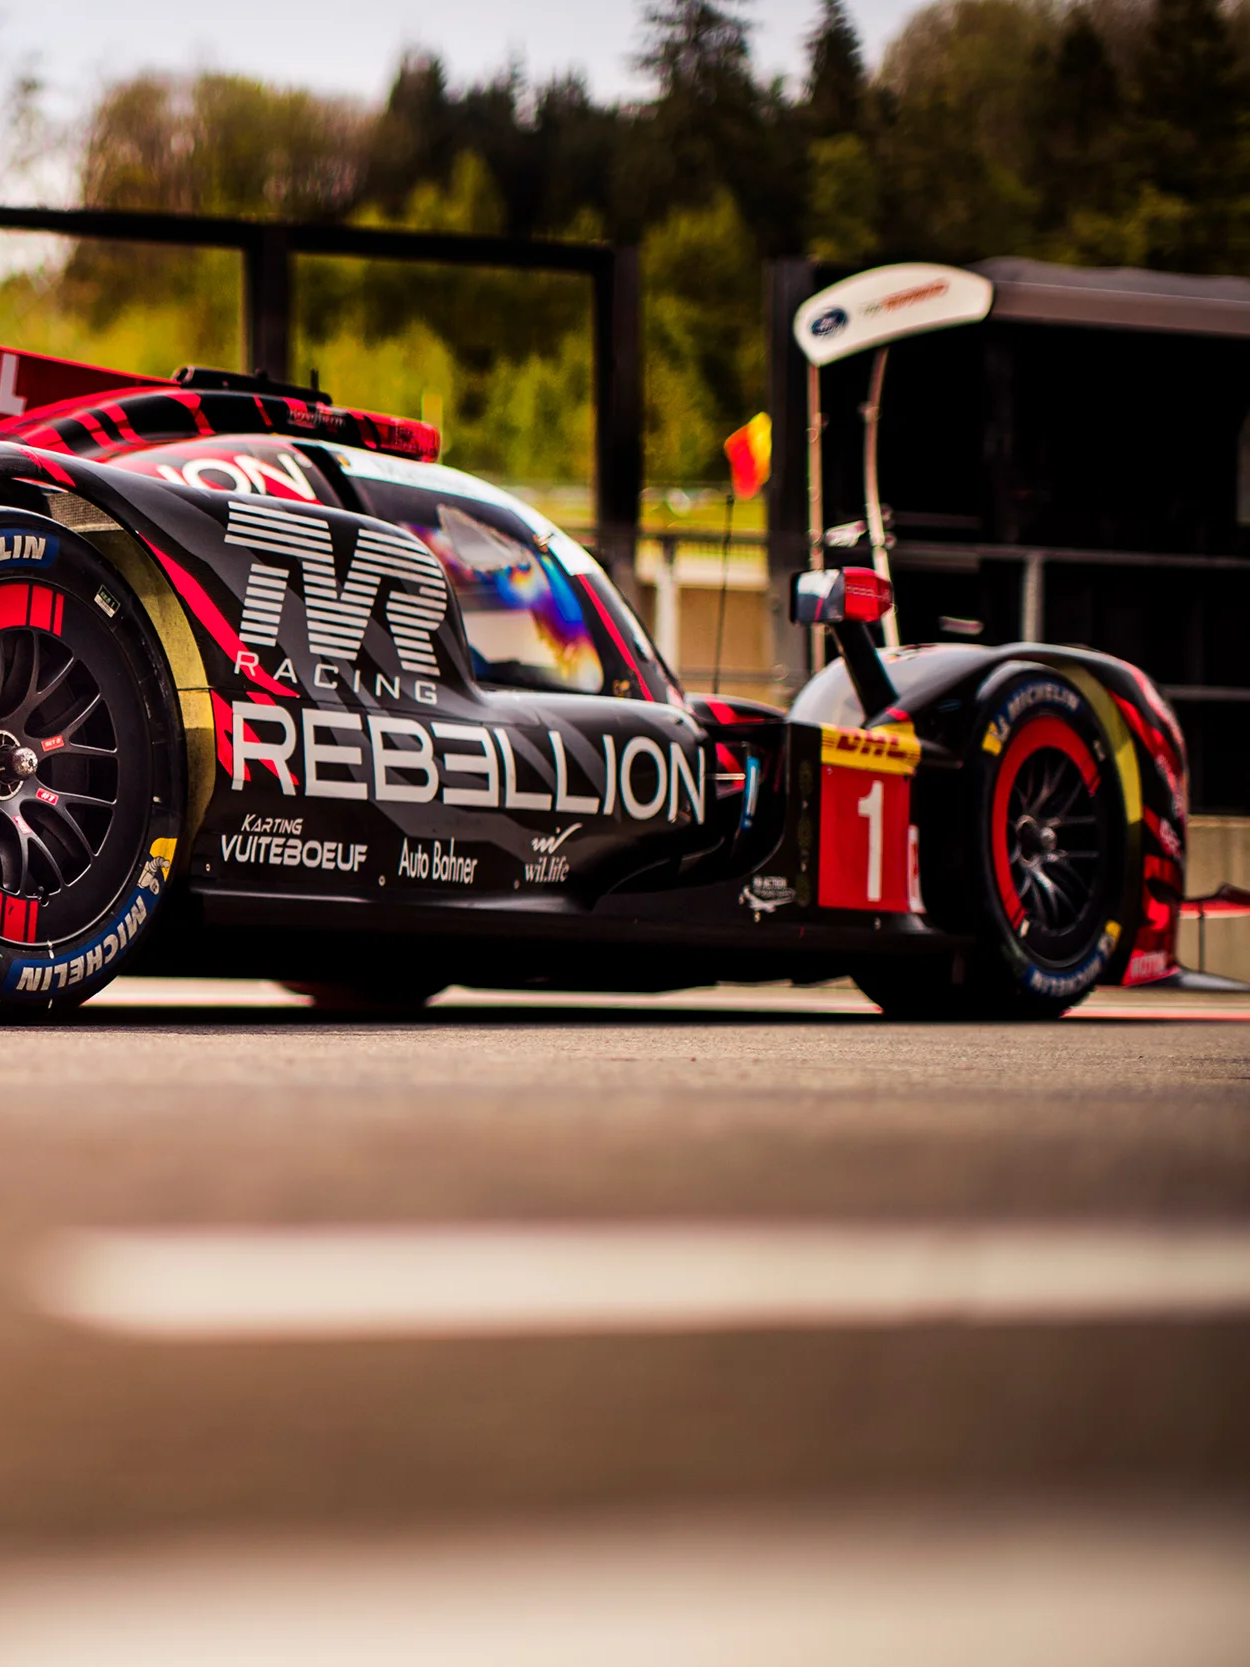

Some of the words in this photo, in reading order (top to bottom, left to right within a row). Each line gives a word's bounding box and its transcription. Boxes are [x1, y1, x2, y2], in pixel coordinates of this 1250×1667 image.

[233, 650, 438, 706] RACING
[231, 701, 706, 825] REBELLION
[221, 834, 368, 872] VUITEBOEUF
[398, 837, 429, 880] Auto
[432, 836, 478, 884] Bahner
[857, 780, 884, 902] 1
[15, 895, 149, 994] MICHELIN
